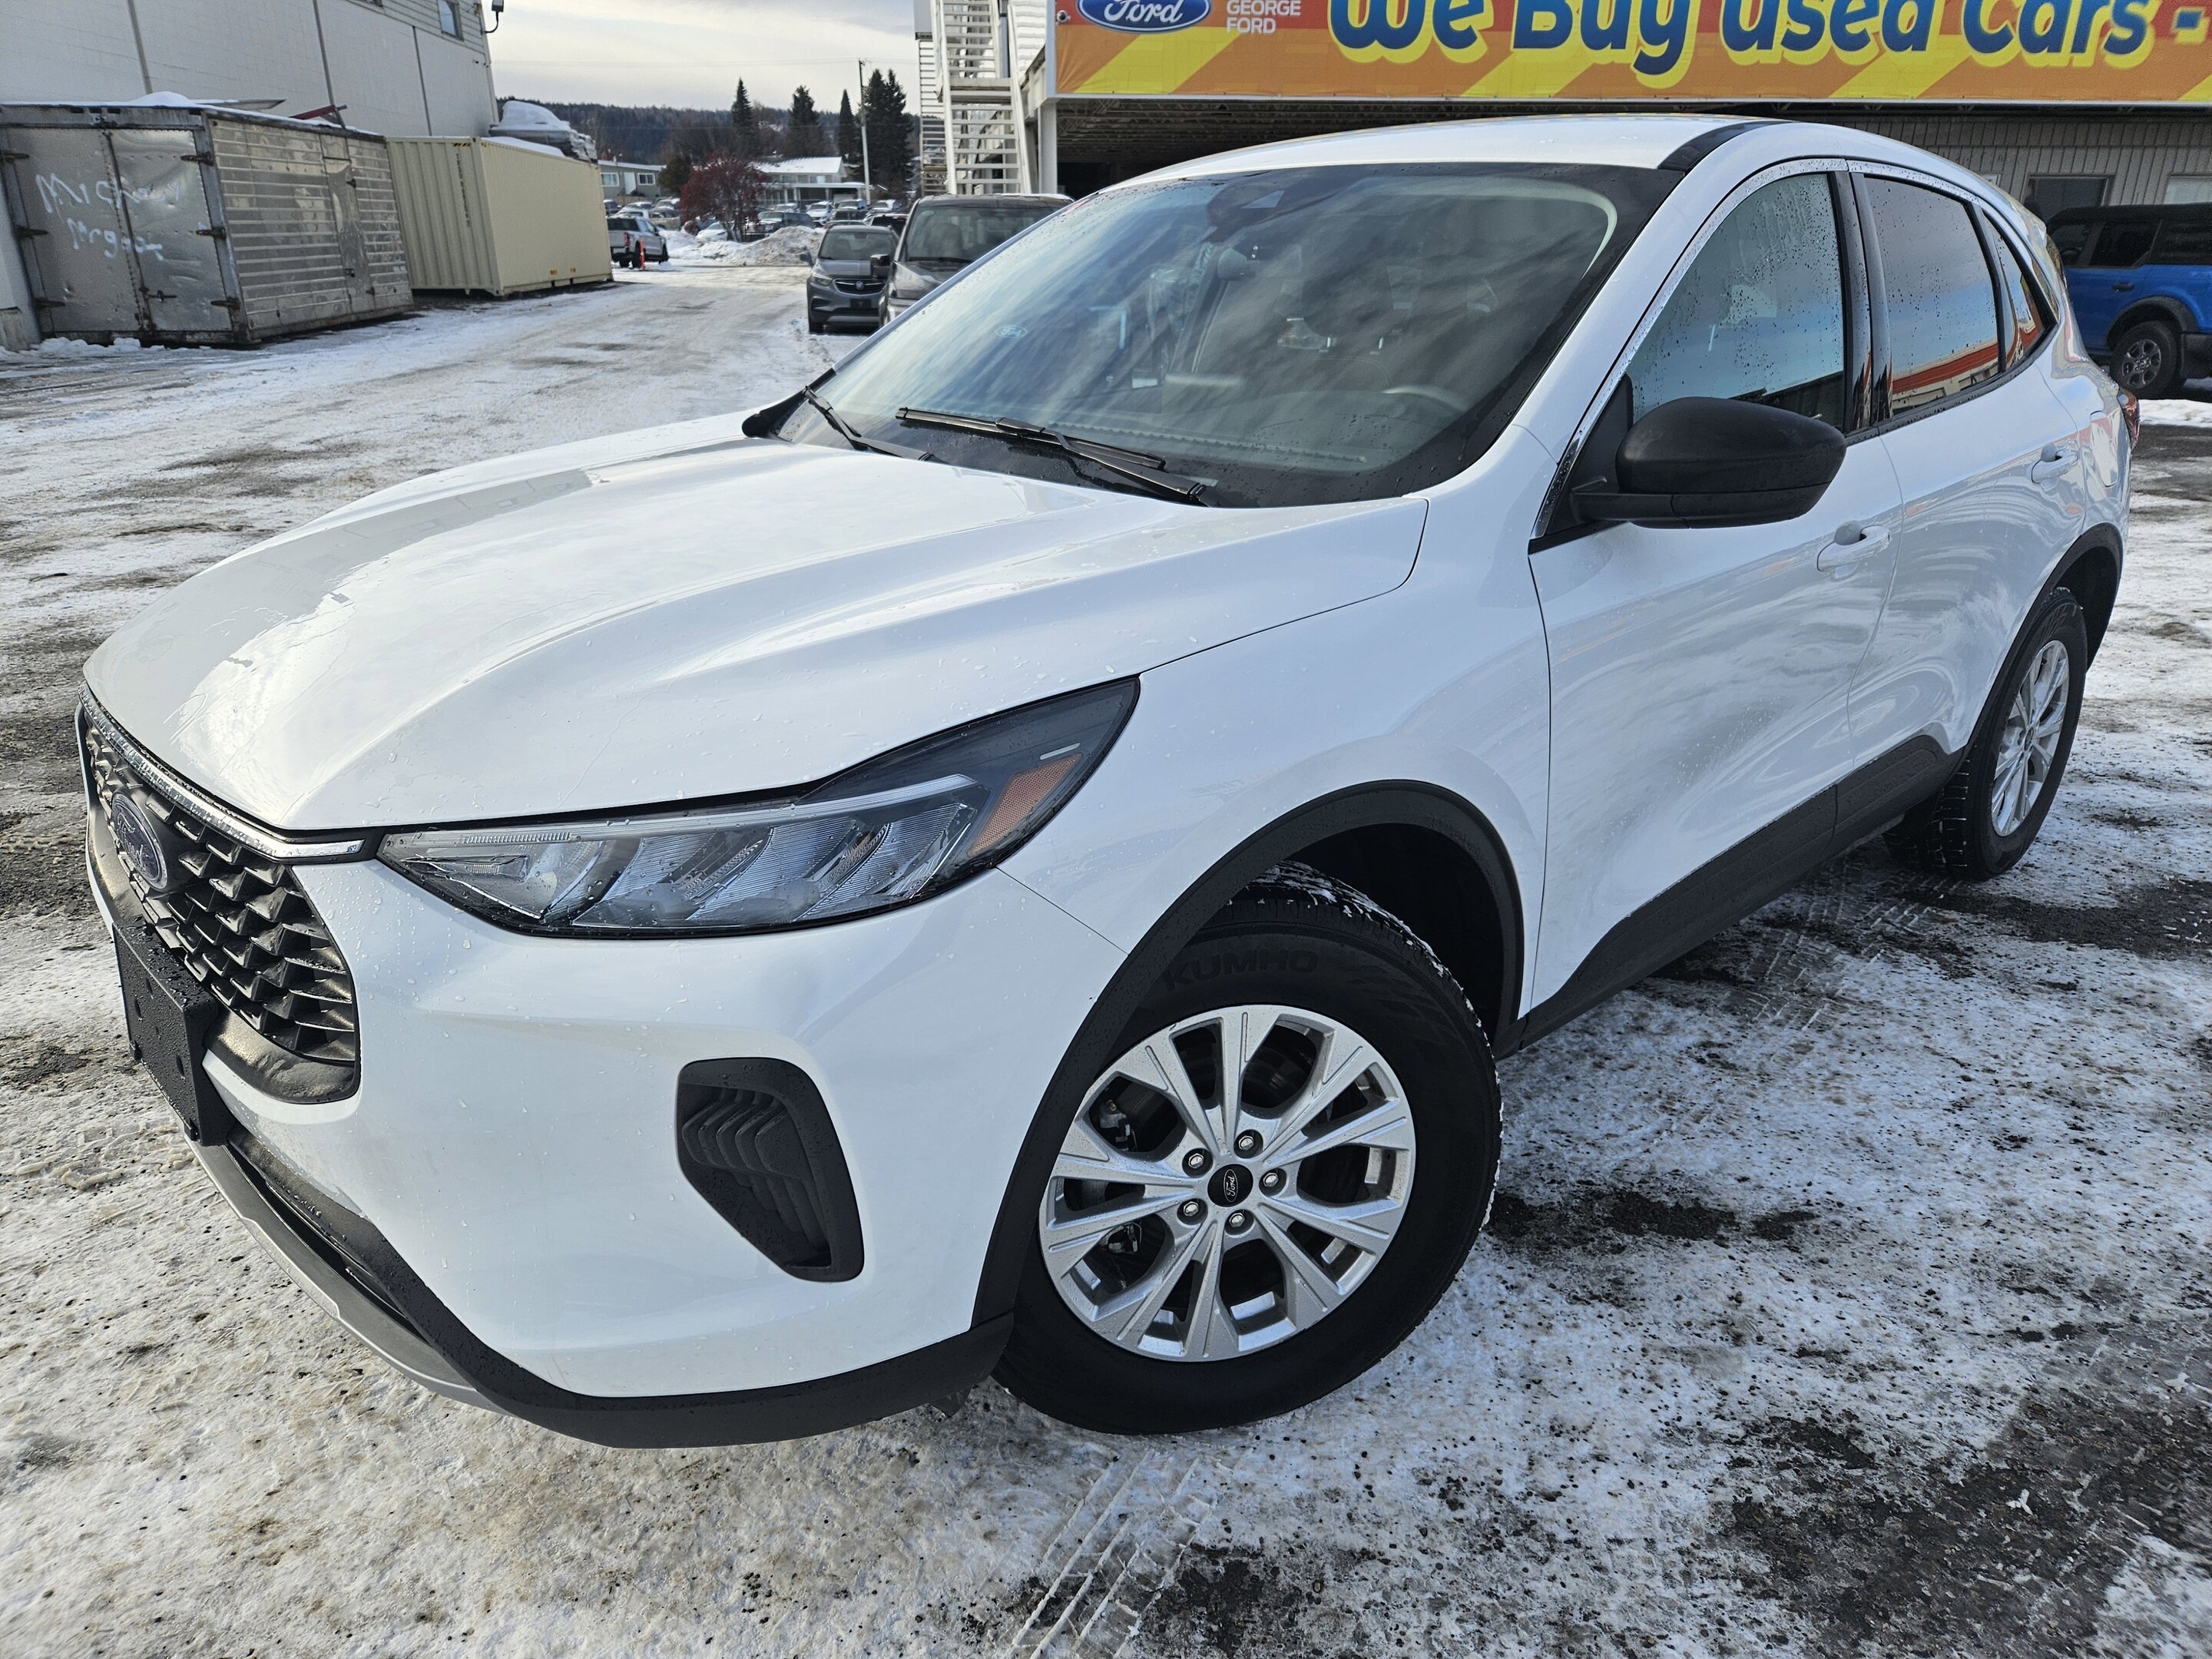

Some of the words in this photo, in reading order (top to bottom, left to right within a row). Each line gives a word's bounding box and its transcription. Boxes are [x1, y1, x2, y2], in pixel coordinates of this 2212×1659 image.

[1104, 0, 1184, 23] Ford
[1227, 0, 1301, 16] GEORGE
[1227, 16, 1276, 34] FORD
[1329, 0, 1486, 50] We
[1512, 0, 1691, 76] Buy
[1960, 0, 2148, 55] Cars
[1162, 949, 1319, 992] KUMHO
